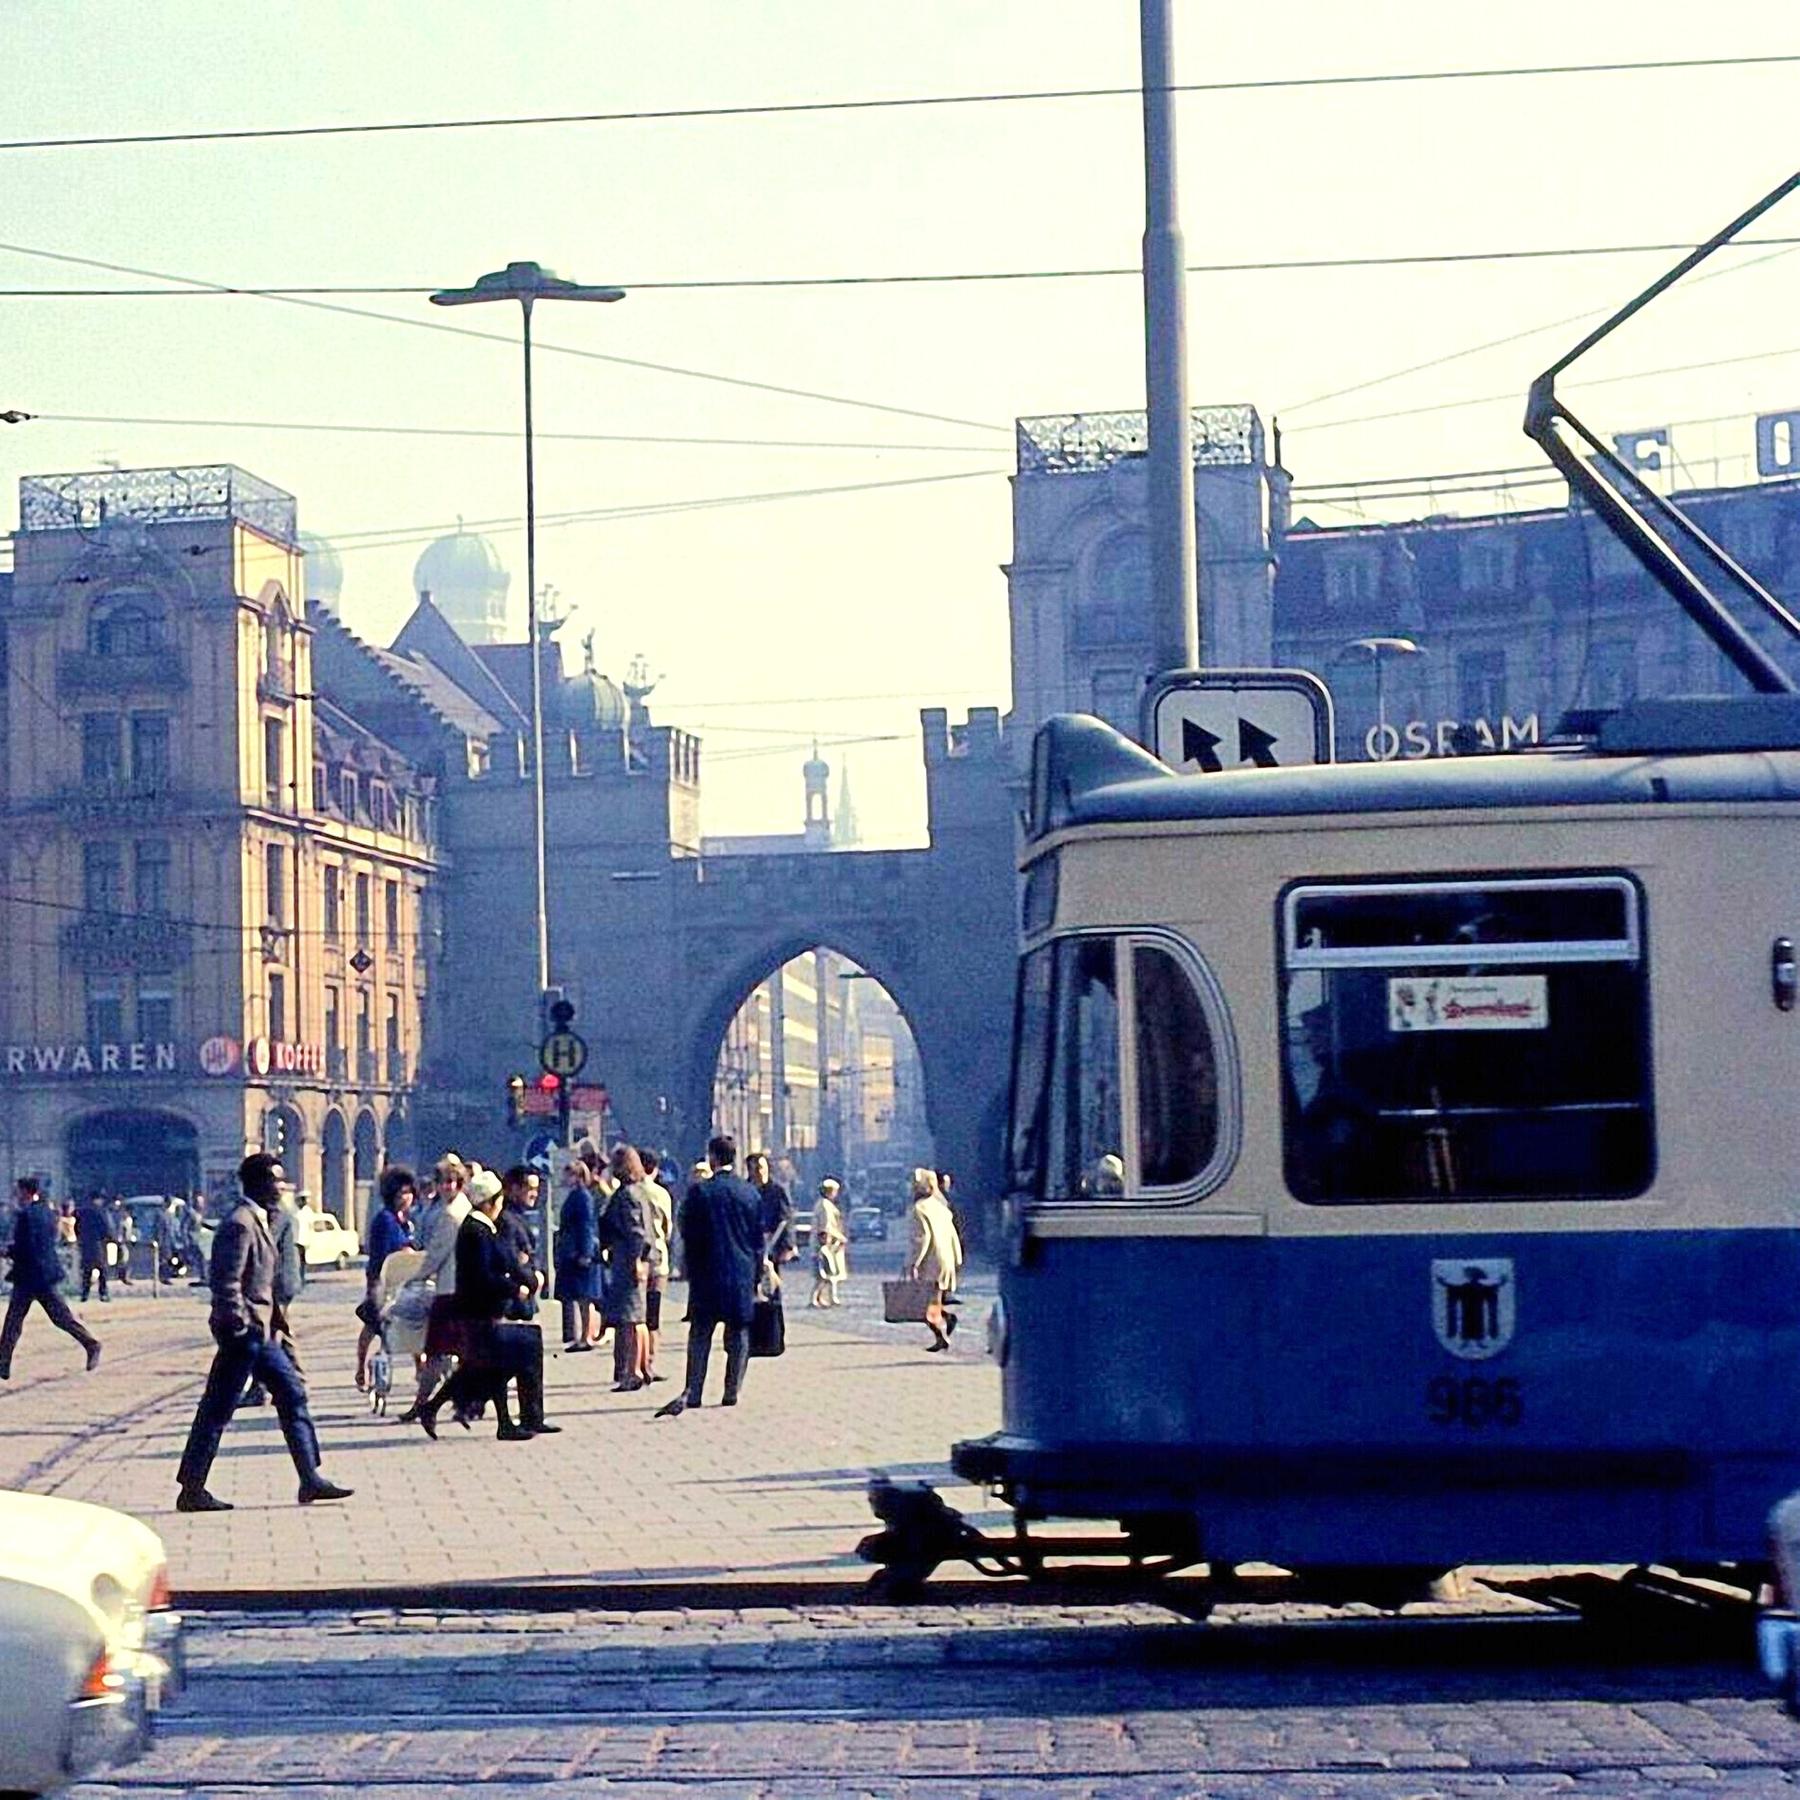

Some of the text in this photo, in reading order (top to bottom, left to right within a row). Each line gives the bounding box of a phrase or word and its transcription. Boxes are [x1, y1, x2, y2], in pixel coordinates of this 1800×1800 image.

[1366, 714, 1538, 761] OSRAM
[8, 1042, 175, 1072] RWAREN
[553, 1040, 576, 1068] H
